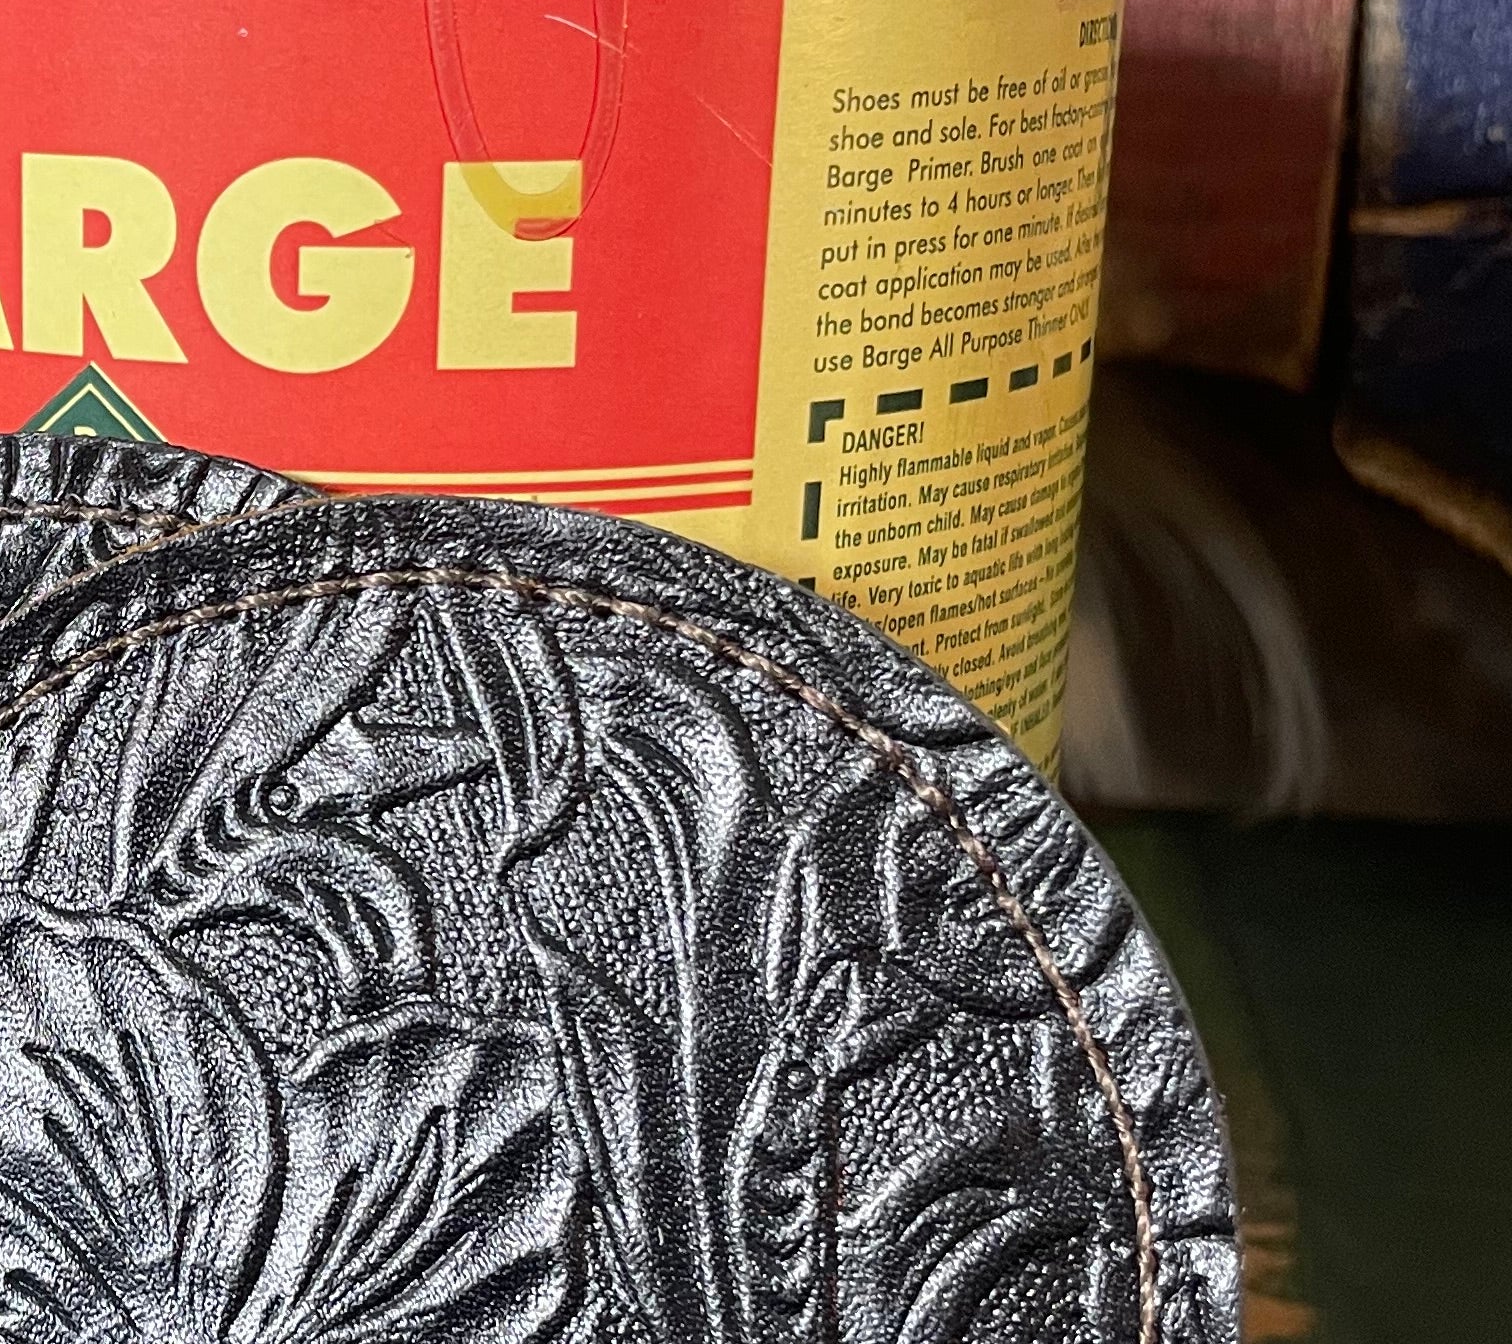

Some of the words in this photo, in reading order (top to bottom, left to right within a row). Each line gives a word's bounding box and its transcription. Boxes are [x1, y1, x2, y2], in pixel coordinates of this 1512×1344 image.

[832, 87, 900, 113] Shoes
[911, 83, 959, 109] must
[968, 77, 989, 103] be
[997, 75, 1026, 100] free
[1033, 67, 1048, 95] of
[1052, 66, 1067, 92] oil
[1070, 72, 1081, 89] or
[829, 125, 884, 152] shoe
[892, 119, 933, 147] and
[939, 116, 981, 143] sole.
[989, 113, 1015, 137] For
[1020, 109, 1048, 134] best
[827, 165, 893, 192] Barge
[908, 157, 973, 182] Primer.
[981, 144, 1023, 174] Brush
[1033, 147, 1057, 167] one
[824, 200, 912, 226] minutes
[920, 196, 939, 218] to
[948, 191, 958, 214] 4
[966, 188, 1012, 213] hours
[1017, 189, 1032, 205] or
[821, 240, 858, 270] put
[867, 236, 886, 259] in
[895, 236, 946, 264] press
[953, 225, 978, 250] for
[983, 227, 1013, 246] one
[1018, 212, 1063, 240] minute.
[818, 275, 867, 301] coat
[876, 261, 982, 301] application
[989, 259, 1022, 282] may
[1026, 248, 1042, 273] be
[816, 312, 852, 337] the
[860, 302, 914, 333] bond
[920, 298, 998, 326] becomes
[1002, 284, 1056, 312] stronger
[814, 354, 853, 374] use
[862, 345, 923, 370] Barge
[929, 332, 954, 360] All
[961, 328, 1022, 357] Purpose
[1028, 312, 1068, 341] Thinner
[840, 462, 892, 489] Highly
[897, 447, 973, 478] flammable
[976, 436, 1010, 465] liquid
[1012, 430, 1031, 454] and
[842, 421, 925, 454] DANGER!
[837, 491, 912, 518] irritation.
[918, 484, 949, 506] May
[952, 473, 990, 498] cause
[993, 459, 1047, 489] respiratory
[835, 529, 862, 549] the
[867, 522, 921, 545] unborn
[927, 508, 964, 534] child.
[970, 504, 995, 525] May
[998, 494, 1028, 517] cause
[833, 555, 912, 583] exposure.
[918, 546, 948, 567] May
[952, 540, 968, 558] be
[972, 529, 998, 555] fatal
[1000, 525, 1009, 546] if
[832, 592, 861, 608] life.
[868, 585, 904, 606] Very
[908, 575, 942, 598] toxic
[946, 573, 959, 590] to
[963, 559, 1006, 587] aquatic
[930, 588, 996, 624] flames/hot
[935, 627, 981, 653] Protect
[984, 618, 1009, 640] from
[952, 648, 995, 678] closed.
